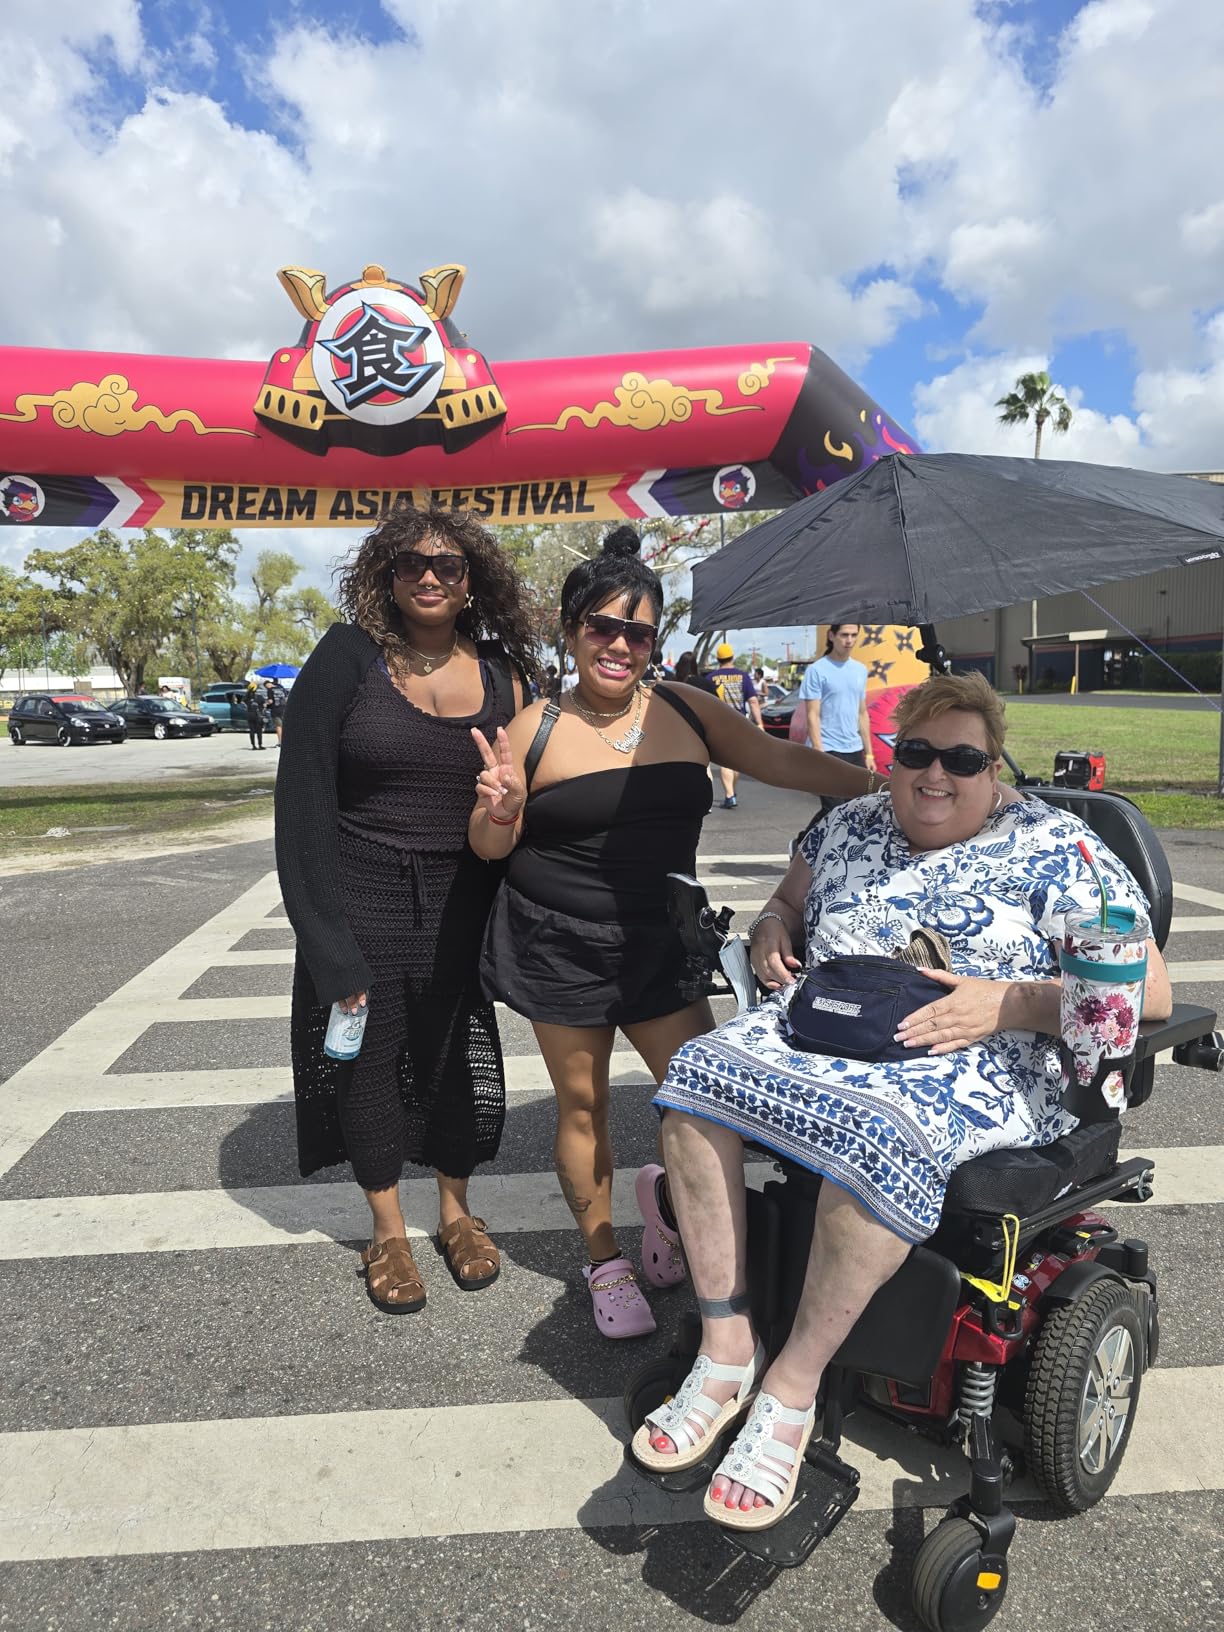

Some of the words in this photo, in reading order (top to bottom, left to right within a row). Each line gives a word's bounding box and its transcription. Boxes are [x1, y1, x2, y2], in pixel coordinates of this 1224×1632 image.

[318, 302, 442, 408] 食
[181, 485, 318, 521] DREAM
[329, 490, 416, 520] ASIA
[430, 479, 595, 518] FESTIVAL
